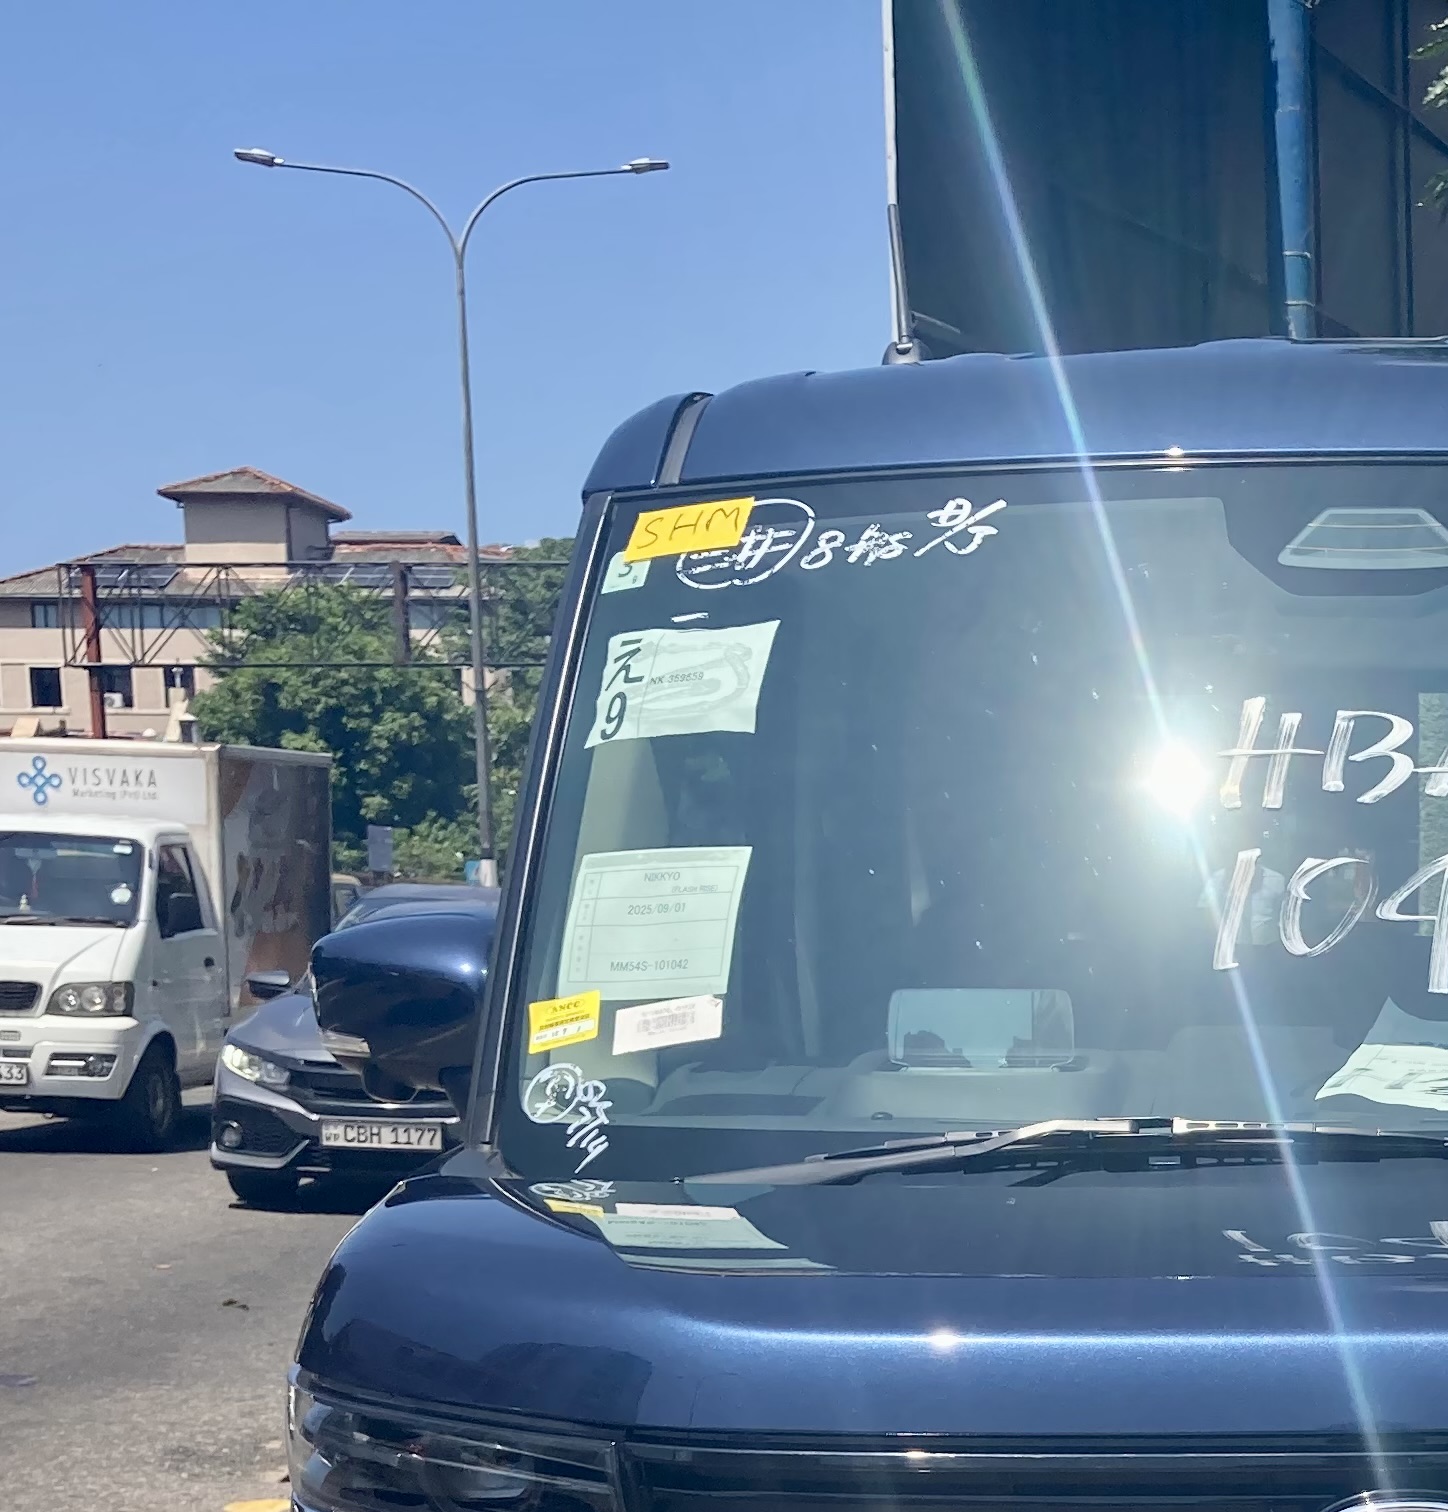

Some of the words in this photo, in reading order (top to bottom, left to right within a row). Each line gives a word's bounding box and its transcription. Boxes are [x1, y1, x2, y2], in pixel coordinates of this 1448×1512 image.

[68, 767, 158, 788] VISVAKA
[643, 871, 681, 882] NIKKYO
[627, 902, 687, 916] 2025/09/01
[610, 958, 689, 972] MM54S-101042
[0, 1063, 24, 1080] 33
[343, 1124, 382, 1144] CBH
[390, 1126, 438, 1146] 1177
